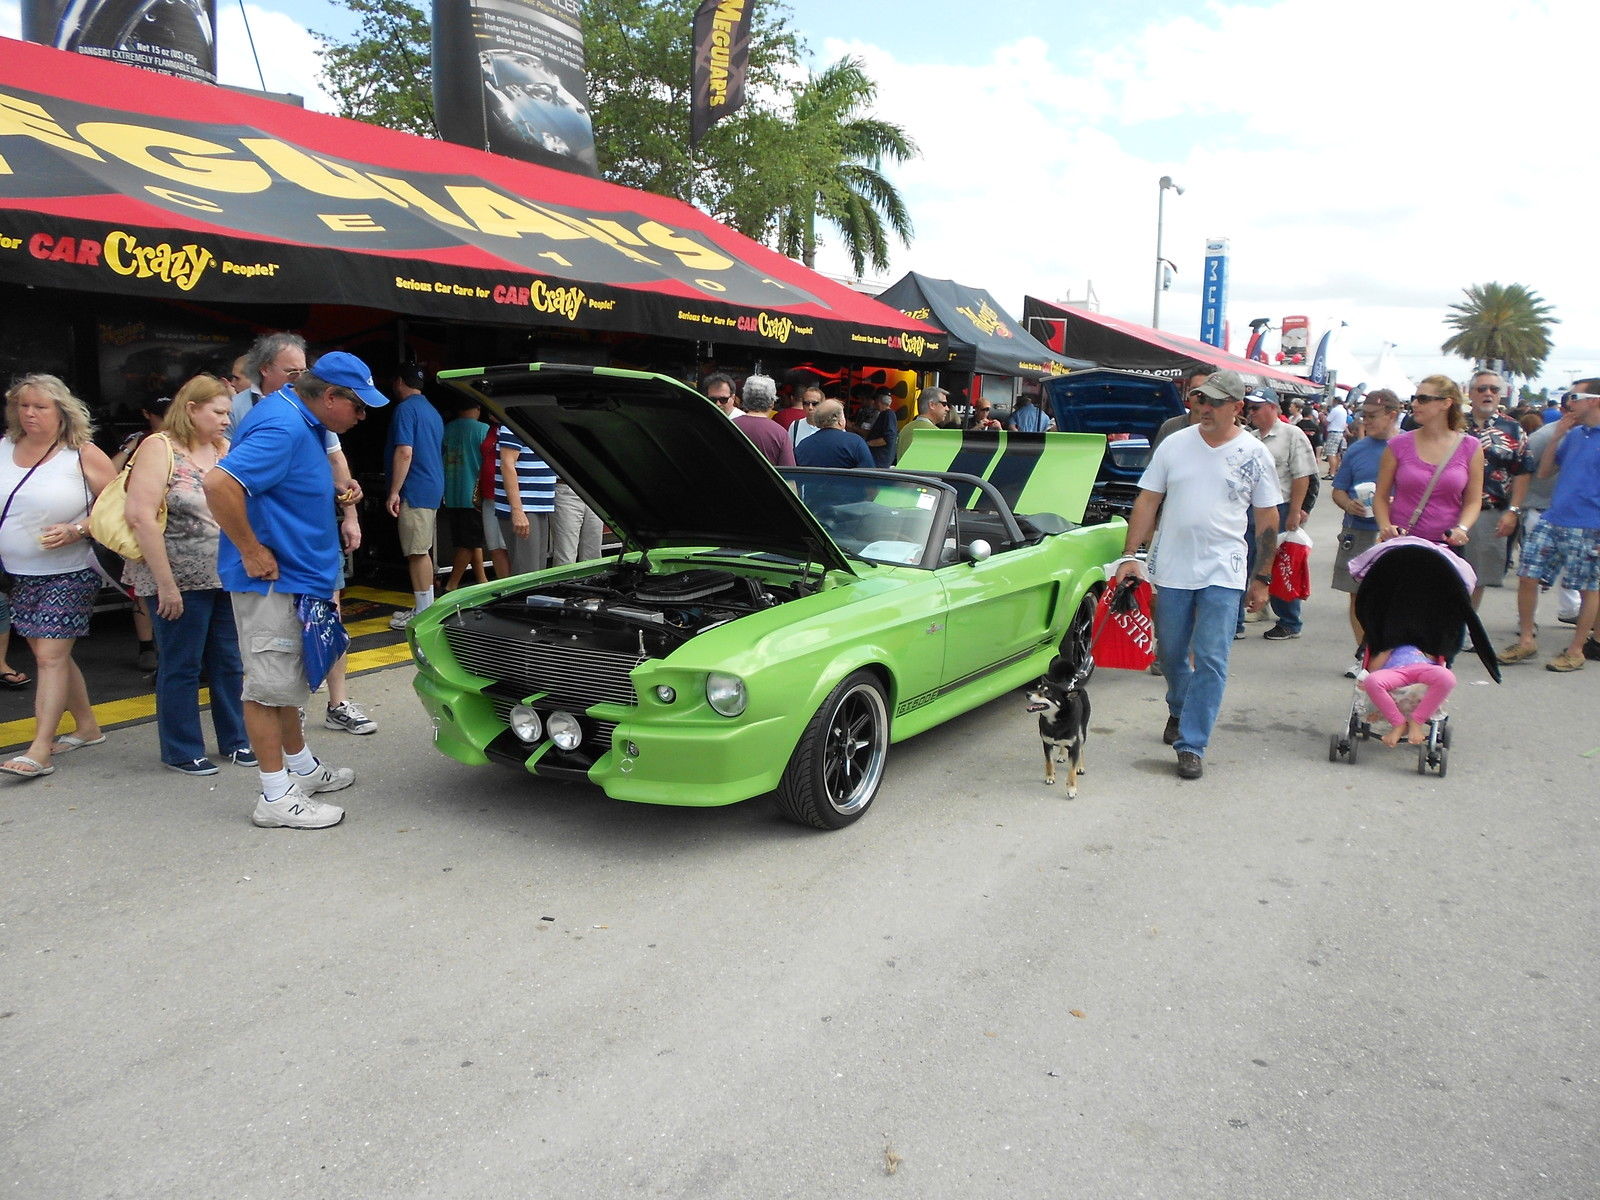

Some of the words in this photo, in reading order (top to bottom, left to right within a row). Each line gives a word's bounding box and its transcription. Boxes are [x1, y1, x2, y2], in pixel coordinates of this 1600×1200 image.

[484, 12, 496, 22] The
[112, 49, 153, 65] EXTREMELY
[154, 56, 191, 74] FLAMMABLE
[136, 42, 150, 53] Net
[151, 45, 160, 54] 15
[161, 48, 169, 56] oz
[28, 232, 102, 267] CAR
[103, 230, 214, 292] Crazy
[221, 261, 275, 278] People!
[395, 276, 433, 293] Serious
[434, 282, 452, 294] Car
[453, 284, 474, 297] Care
[475, 286, 491, 298] for
[492, 284, 530, 306] CAR
[530, 279, 584, 321] Crazy
[678, 310, 701, 322] Serious
[701, 314, 713, 324] Car
[713, 316, 725, 326] Care
[726, 317, 737, 327] for
[737, 315, 758, 332] CAR
[758, 311, 793, 344] Crazy
